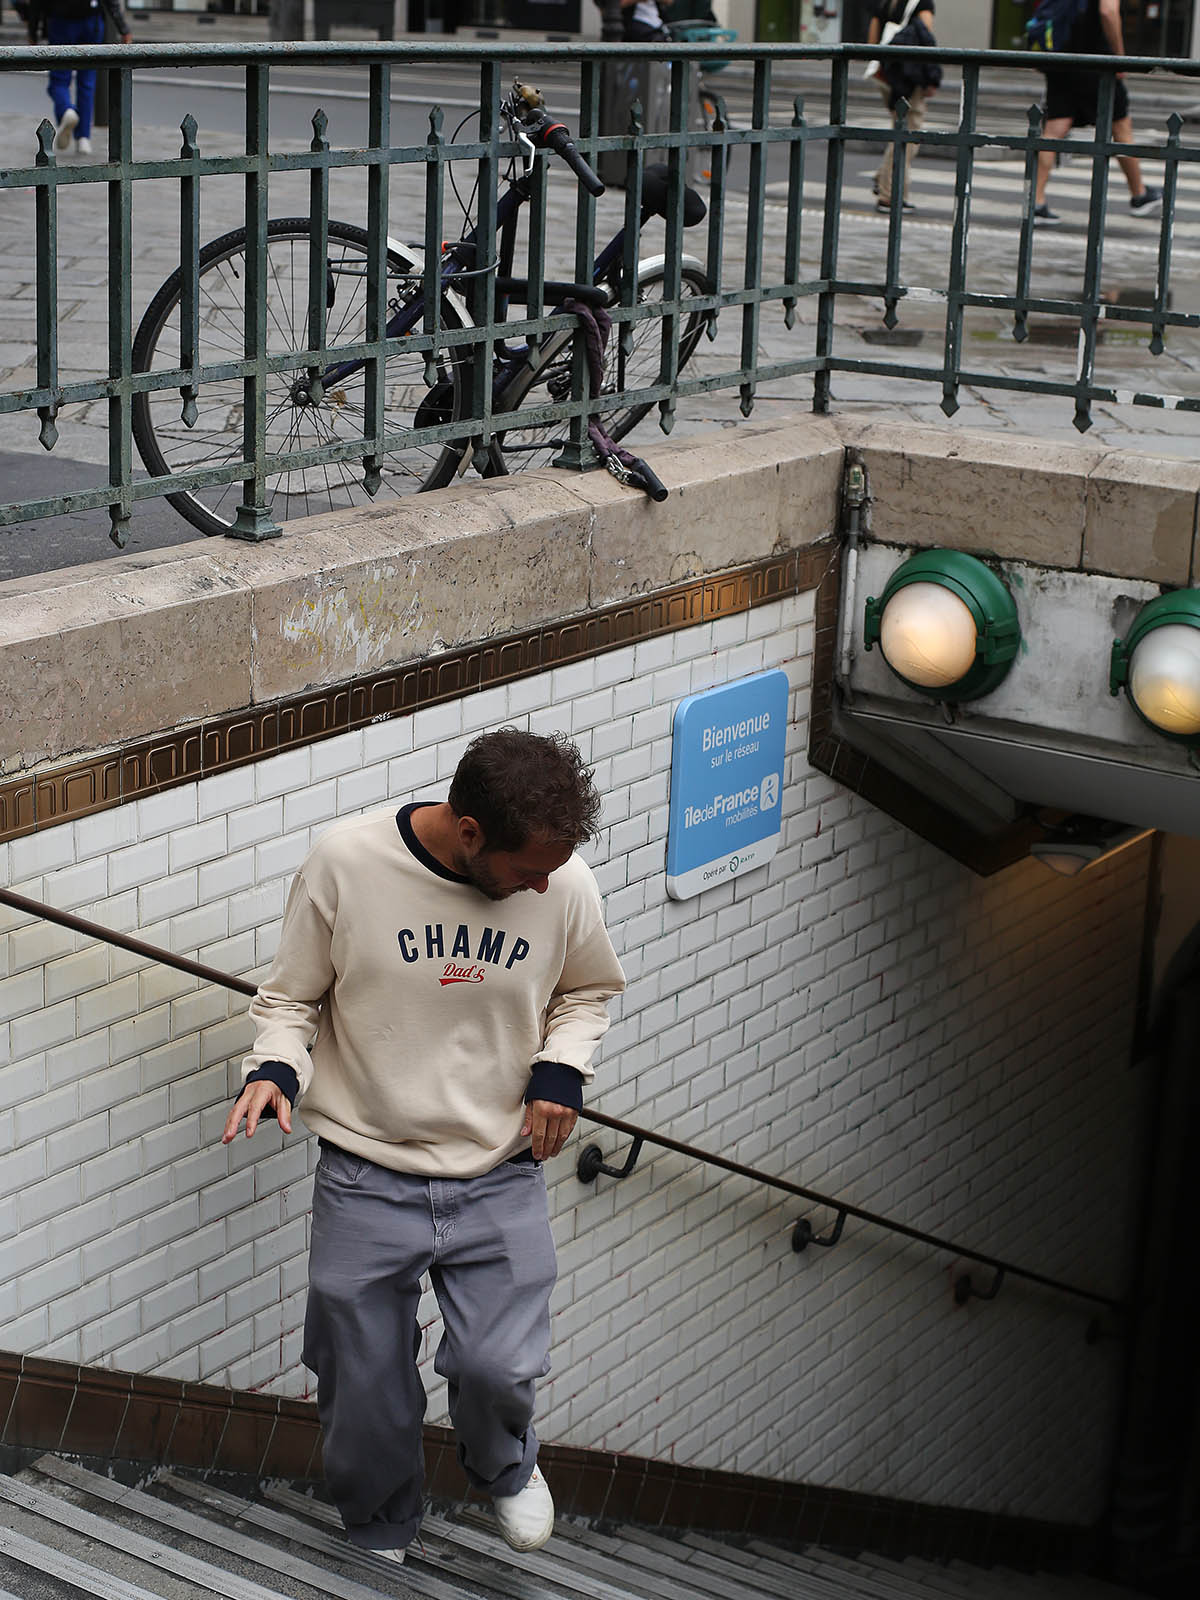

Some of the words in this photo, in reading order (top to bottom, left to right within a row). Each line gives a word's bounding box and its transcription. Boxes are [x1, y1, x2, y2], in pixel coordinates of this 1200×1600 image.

[702, 712, 770, 753] Bienvenue
[711, 754, 724, 769] sur
[725, 749, 733, 764] le
[734, 741, 760, 760] réseau
[725, 805, 759, 828] mobilités
[397, 923, 530, 970] CHAMP
[442, 962, 486, 982] Dad's
